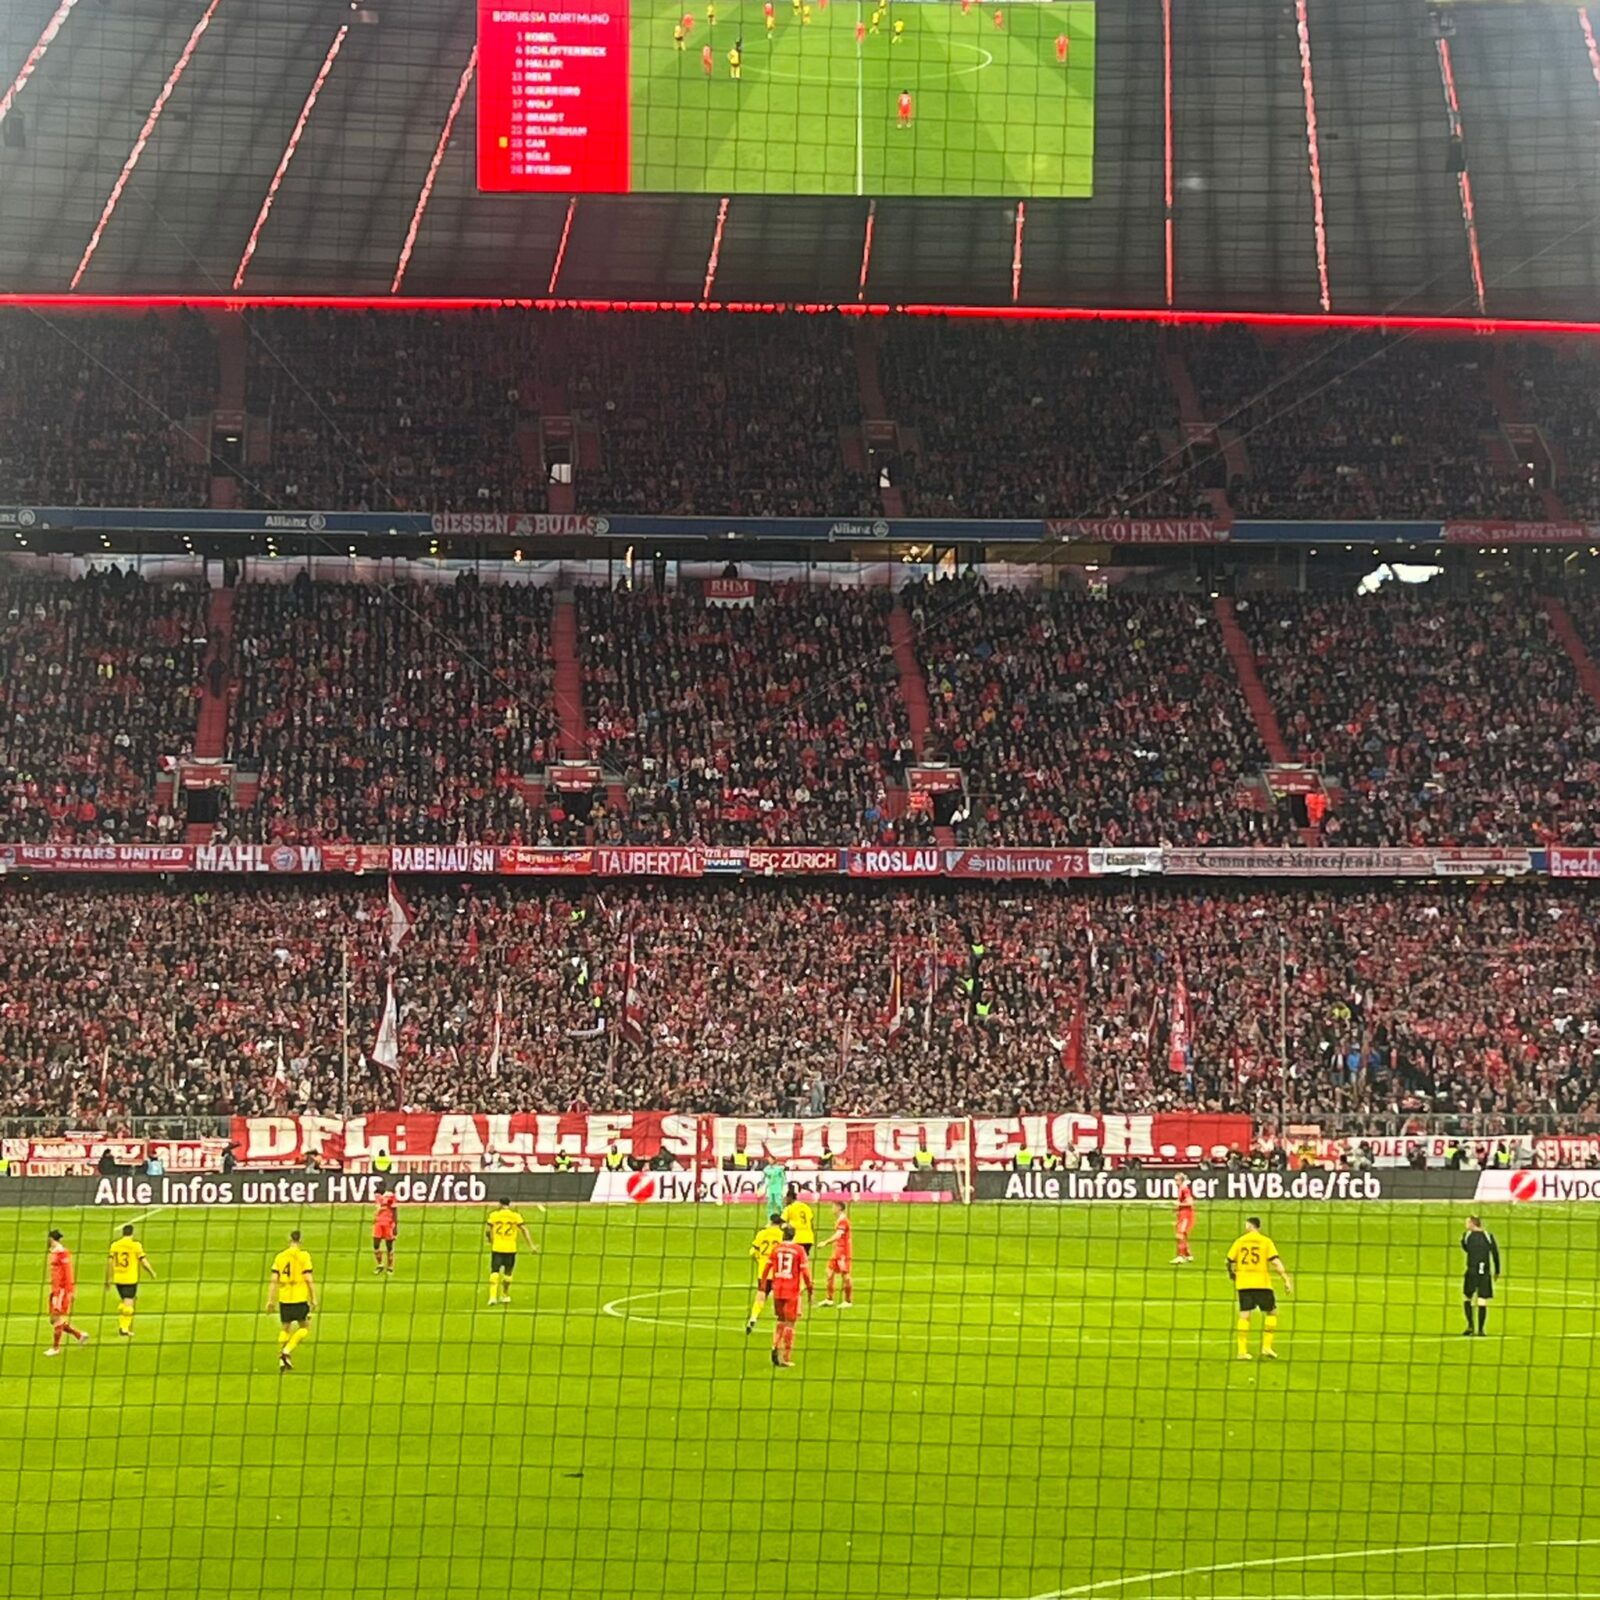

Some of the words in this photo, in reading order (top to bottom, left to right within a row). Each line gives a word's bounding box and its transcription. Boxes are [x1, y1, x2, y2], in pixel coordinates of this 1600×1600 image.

[492, 11, 547, 23] BORUSSIA
[548, 12, 610, 25] DORTMUND
[265, 515, 307, 528] Allianz
[431, 514, 508, 535] GIESSEN
[535, 516, 600, 536] BULLS
[1130, 521, 1213, 543] FRANKEN
[22, 847, 57, 859] RED
[60, 848, 116, 860] STARS
[120, 848, 184, 861] UNITED
[599, 850, 703, 875] TAUBERTAL
[749, 852, 779, 869] BFC
[431, 1114, 633, 1156] ALLE
[94, 1177, 152, 1204] Alle
[161, 1176, 234, 1204] Infos
[242, 1177, 319, 1203] unter
[1005, 1172, 1061, 1199] Alle
[1068, 1172, 1136, 1199] Infos
[1227, 1171, 1381, 1200] HVB.de/fcb
[495, 1221, 513, 1237] 22
[113, 1251, 129, 1268] 13
[776, 1252, 794, 1270] 13
[1240, 1246, 1261, 1265] 25
[281, 1261, 291, 1277] 4
